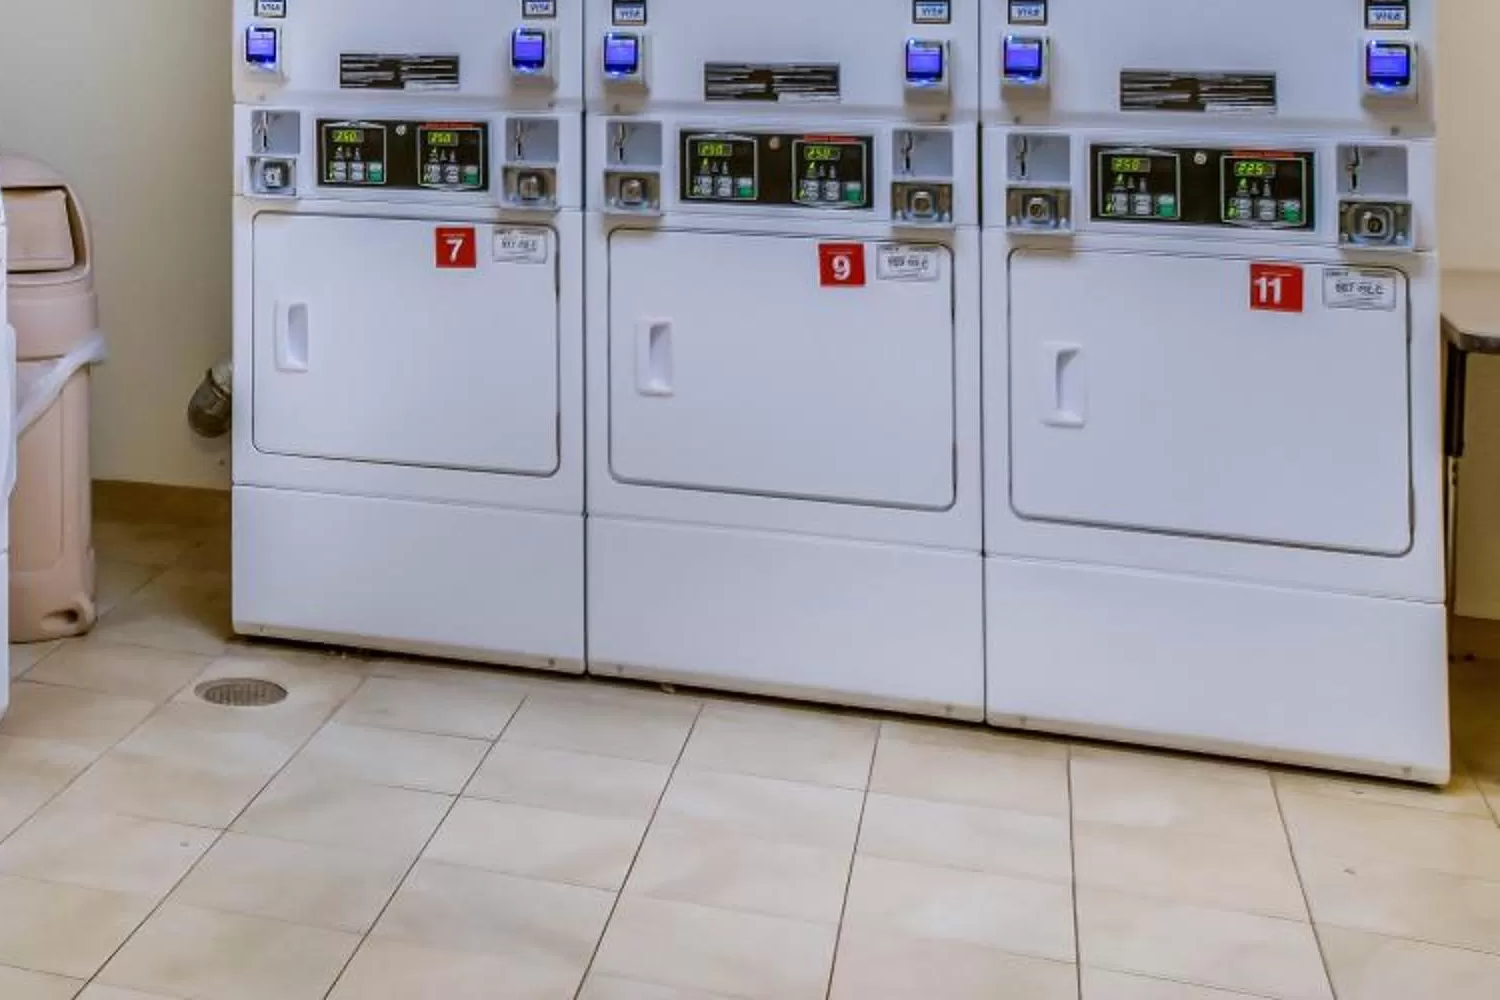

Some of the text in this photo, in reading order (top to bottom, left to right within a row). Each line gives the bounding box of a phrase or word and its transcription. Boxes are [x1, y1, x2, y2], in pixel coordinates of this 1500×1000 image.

[446, 238, 464, 263] 7
[831, 255, 851, 281] 9
[1254, 276, 1283, 304] 11
